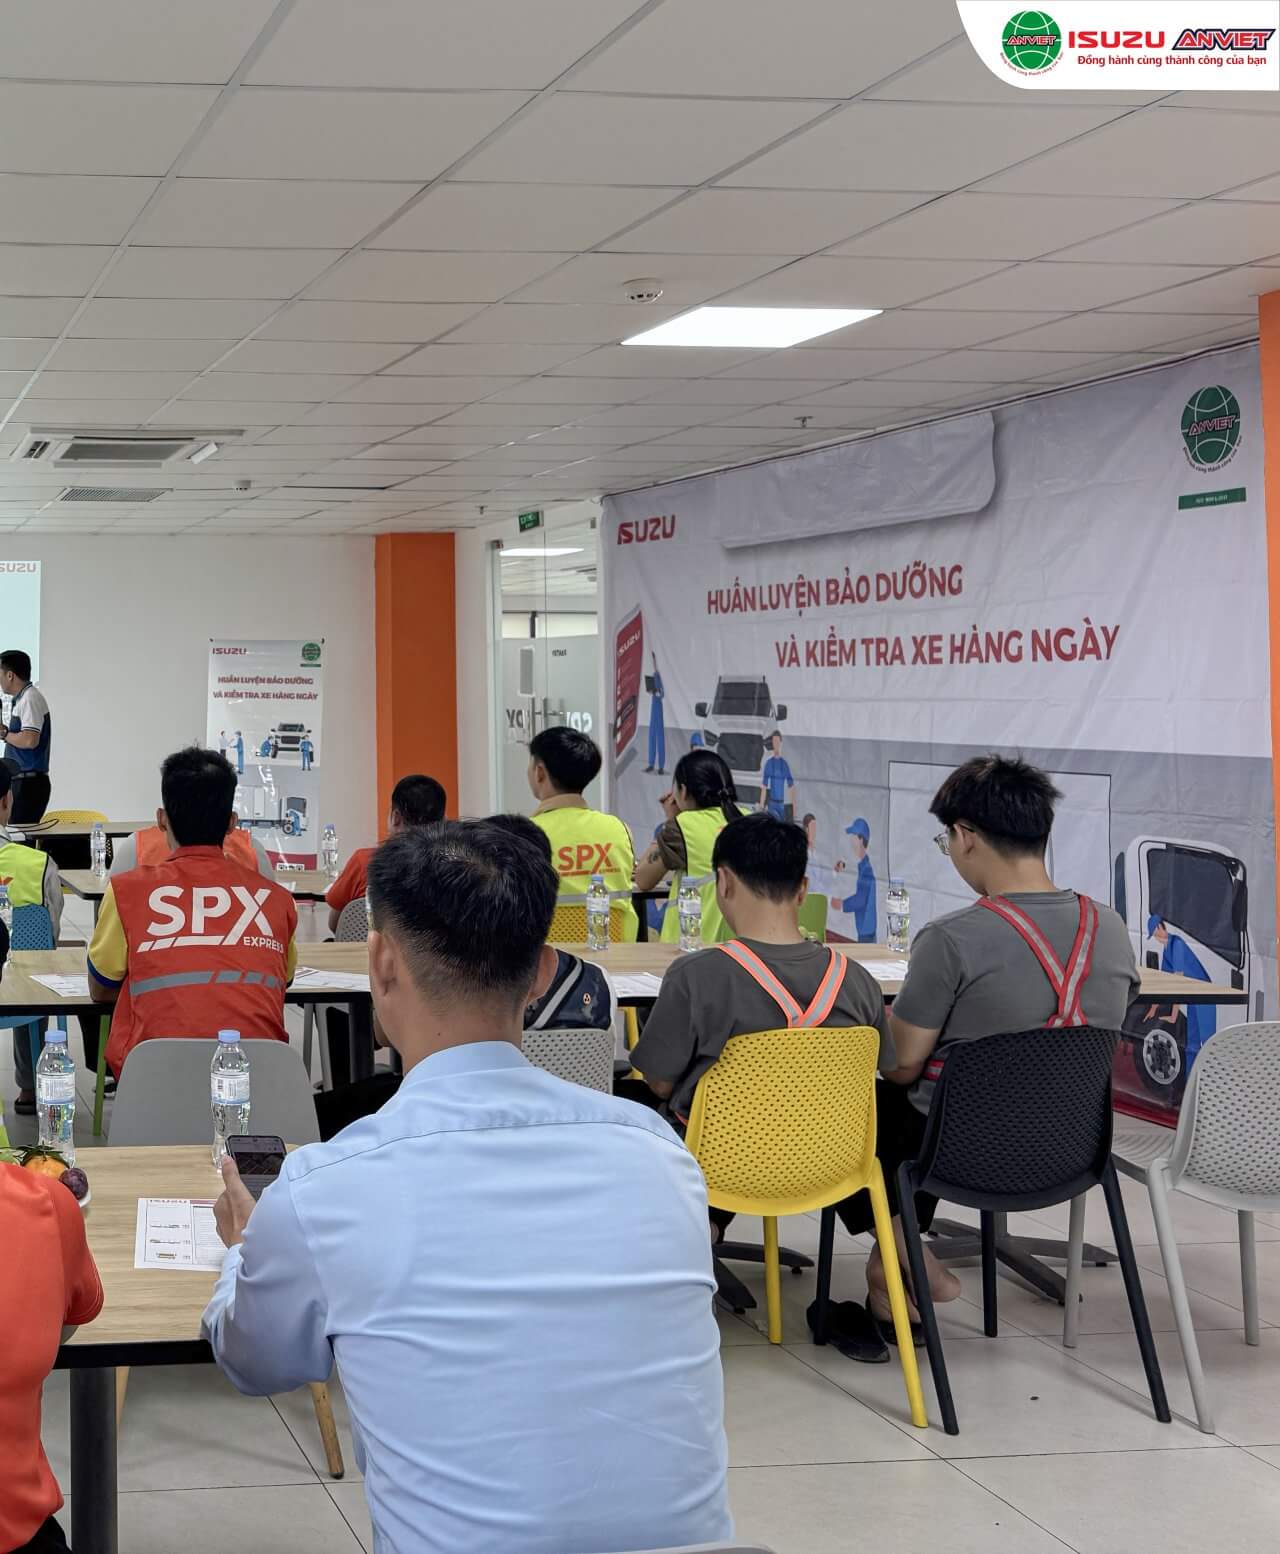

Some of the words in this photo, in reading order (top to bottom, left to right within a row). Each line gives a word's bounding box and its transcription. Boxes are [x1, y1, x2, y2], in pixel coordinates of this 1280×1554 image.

[1188, 415, 1236, 436] ANVIET
[707, 576, 756, 615] HUẤN
[759, 574, 819, 617] LUYỆN
[826, 567, 870, 604] BẢO
[876, 560, 963, 602] DƯỠNG
[212, 647, 247, 655] ISUZU
[775, 634, 801, 668] VÀ
[805, 625, 856, 668] KIỂM
[861, 636, 905, 667] TRA
[912, 634, 943, 666] XE
[950, 624, 1023, 665] HÀNG
[1031, 617, 1121, 663] NGÀY
[261, 691, 272, 699] XE
[558, 842, 612, 874] SPX
[147, 886, 274, 946] SPX
[243, 936, 284, 955] EXPRESS
